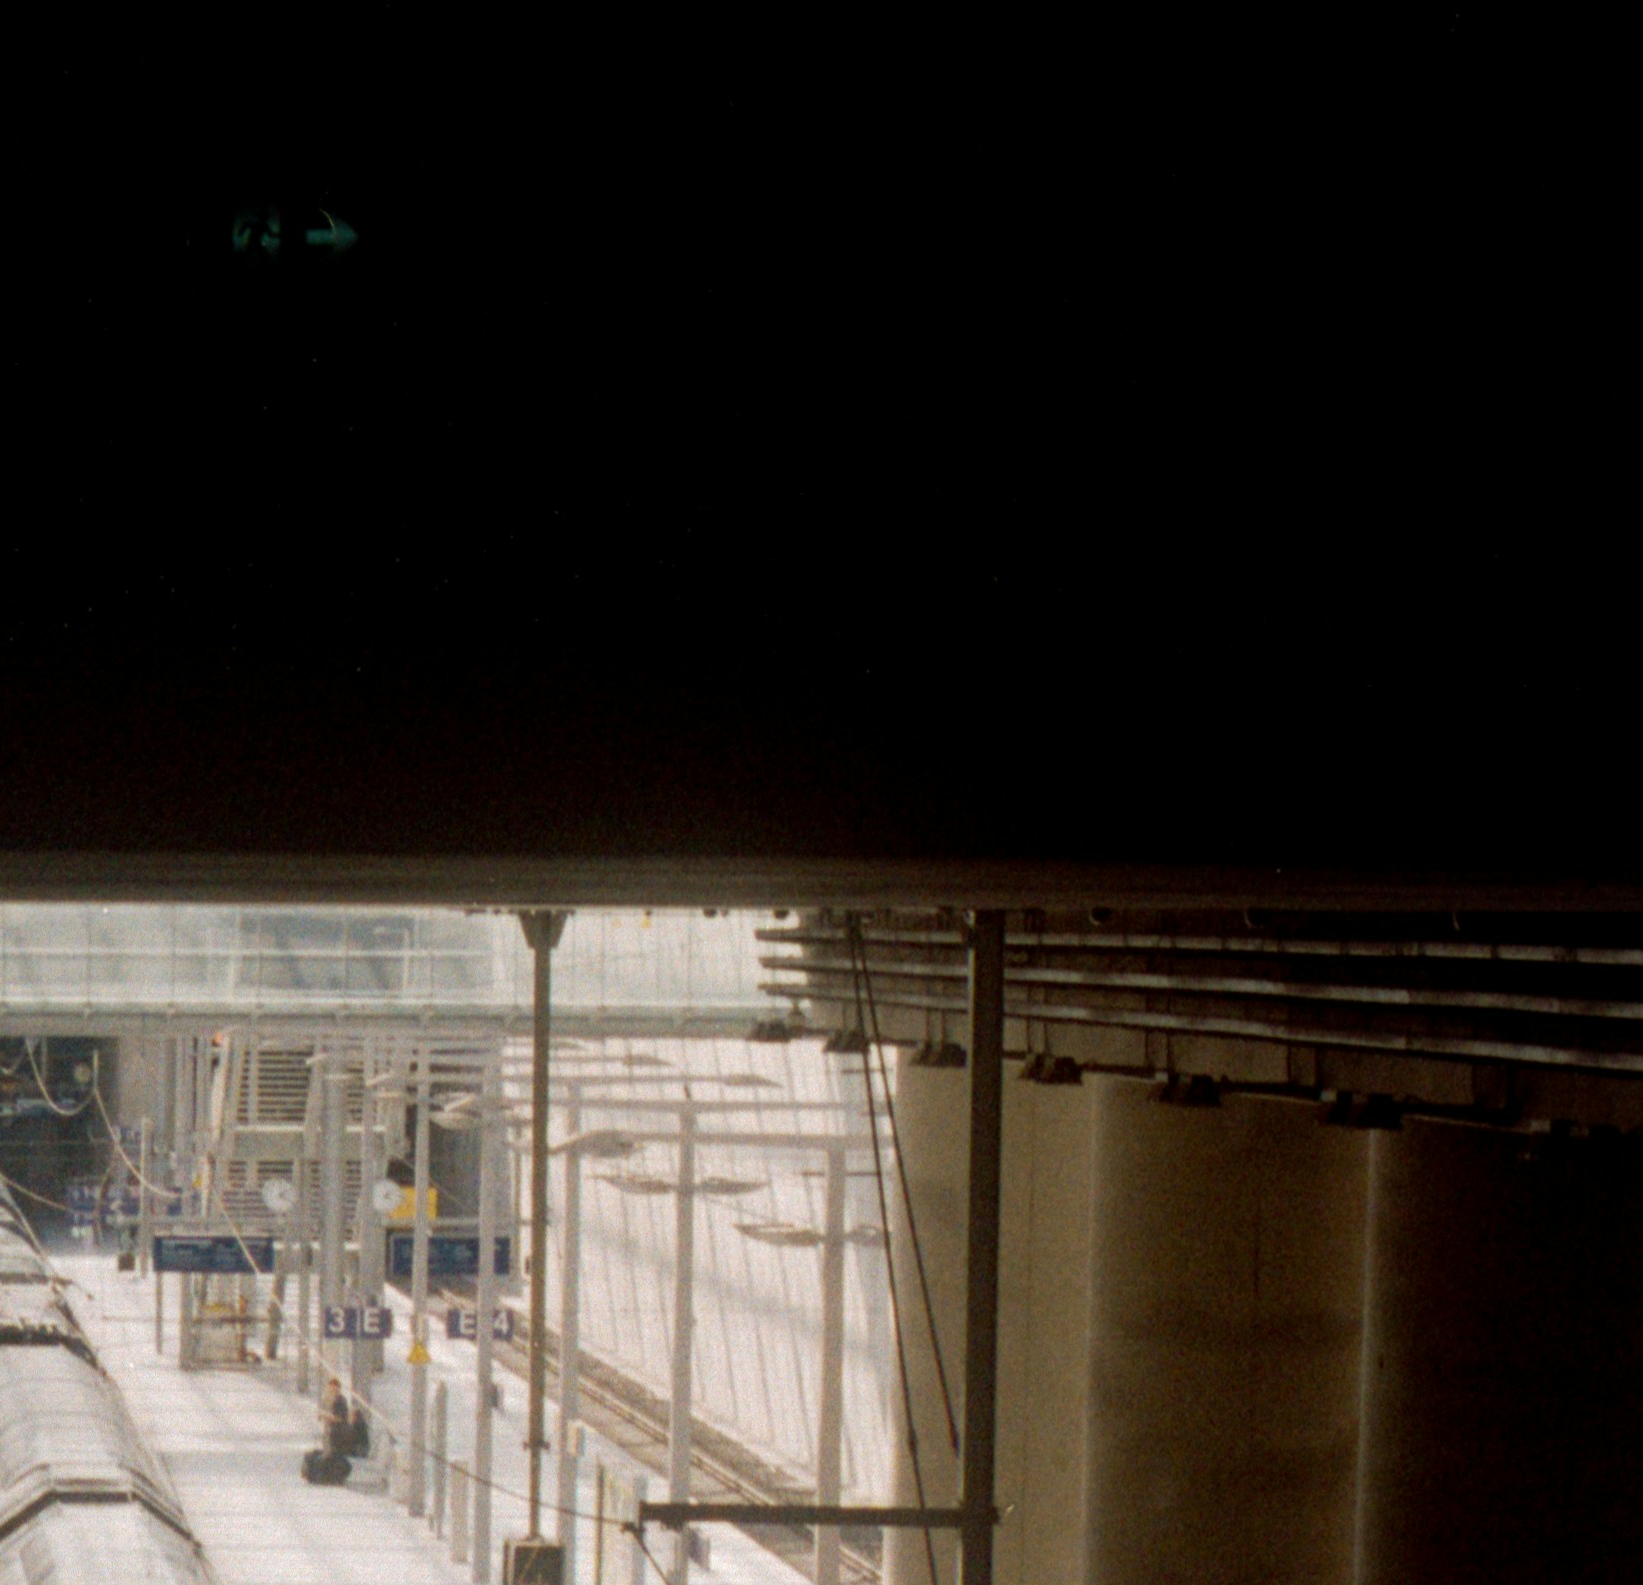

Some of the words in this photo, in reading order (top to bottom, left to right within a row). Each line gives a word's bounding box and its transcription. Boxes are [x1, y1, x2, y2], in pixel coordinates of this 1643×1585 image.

[328, 1306, 345, 1334] 3
[364, 1306, 381, 1334] E
[459, 1309, 476, 1335] E
[493, 1308, 510, 1336] 4
